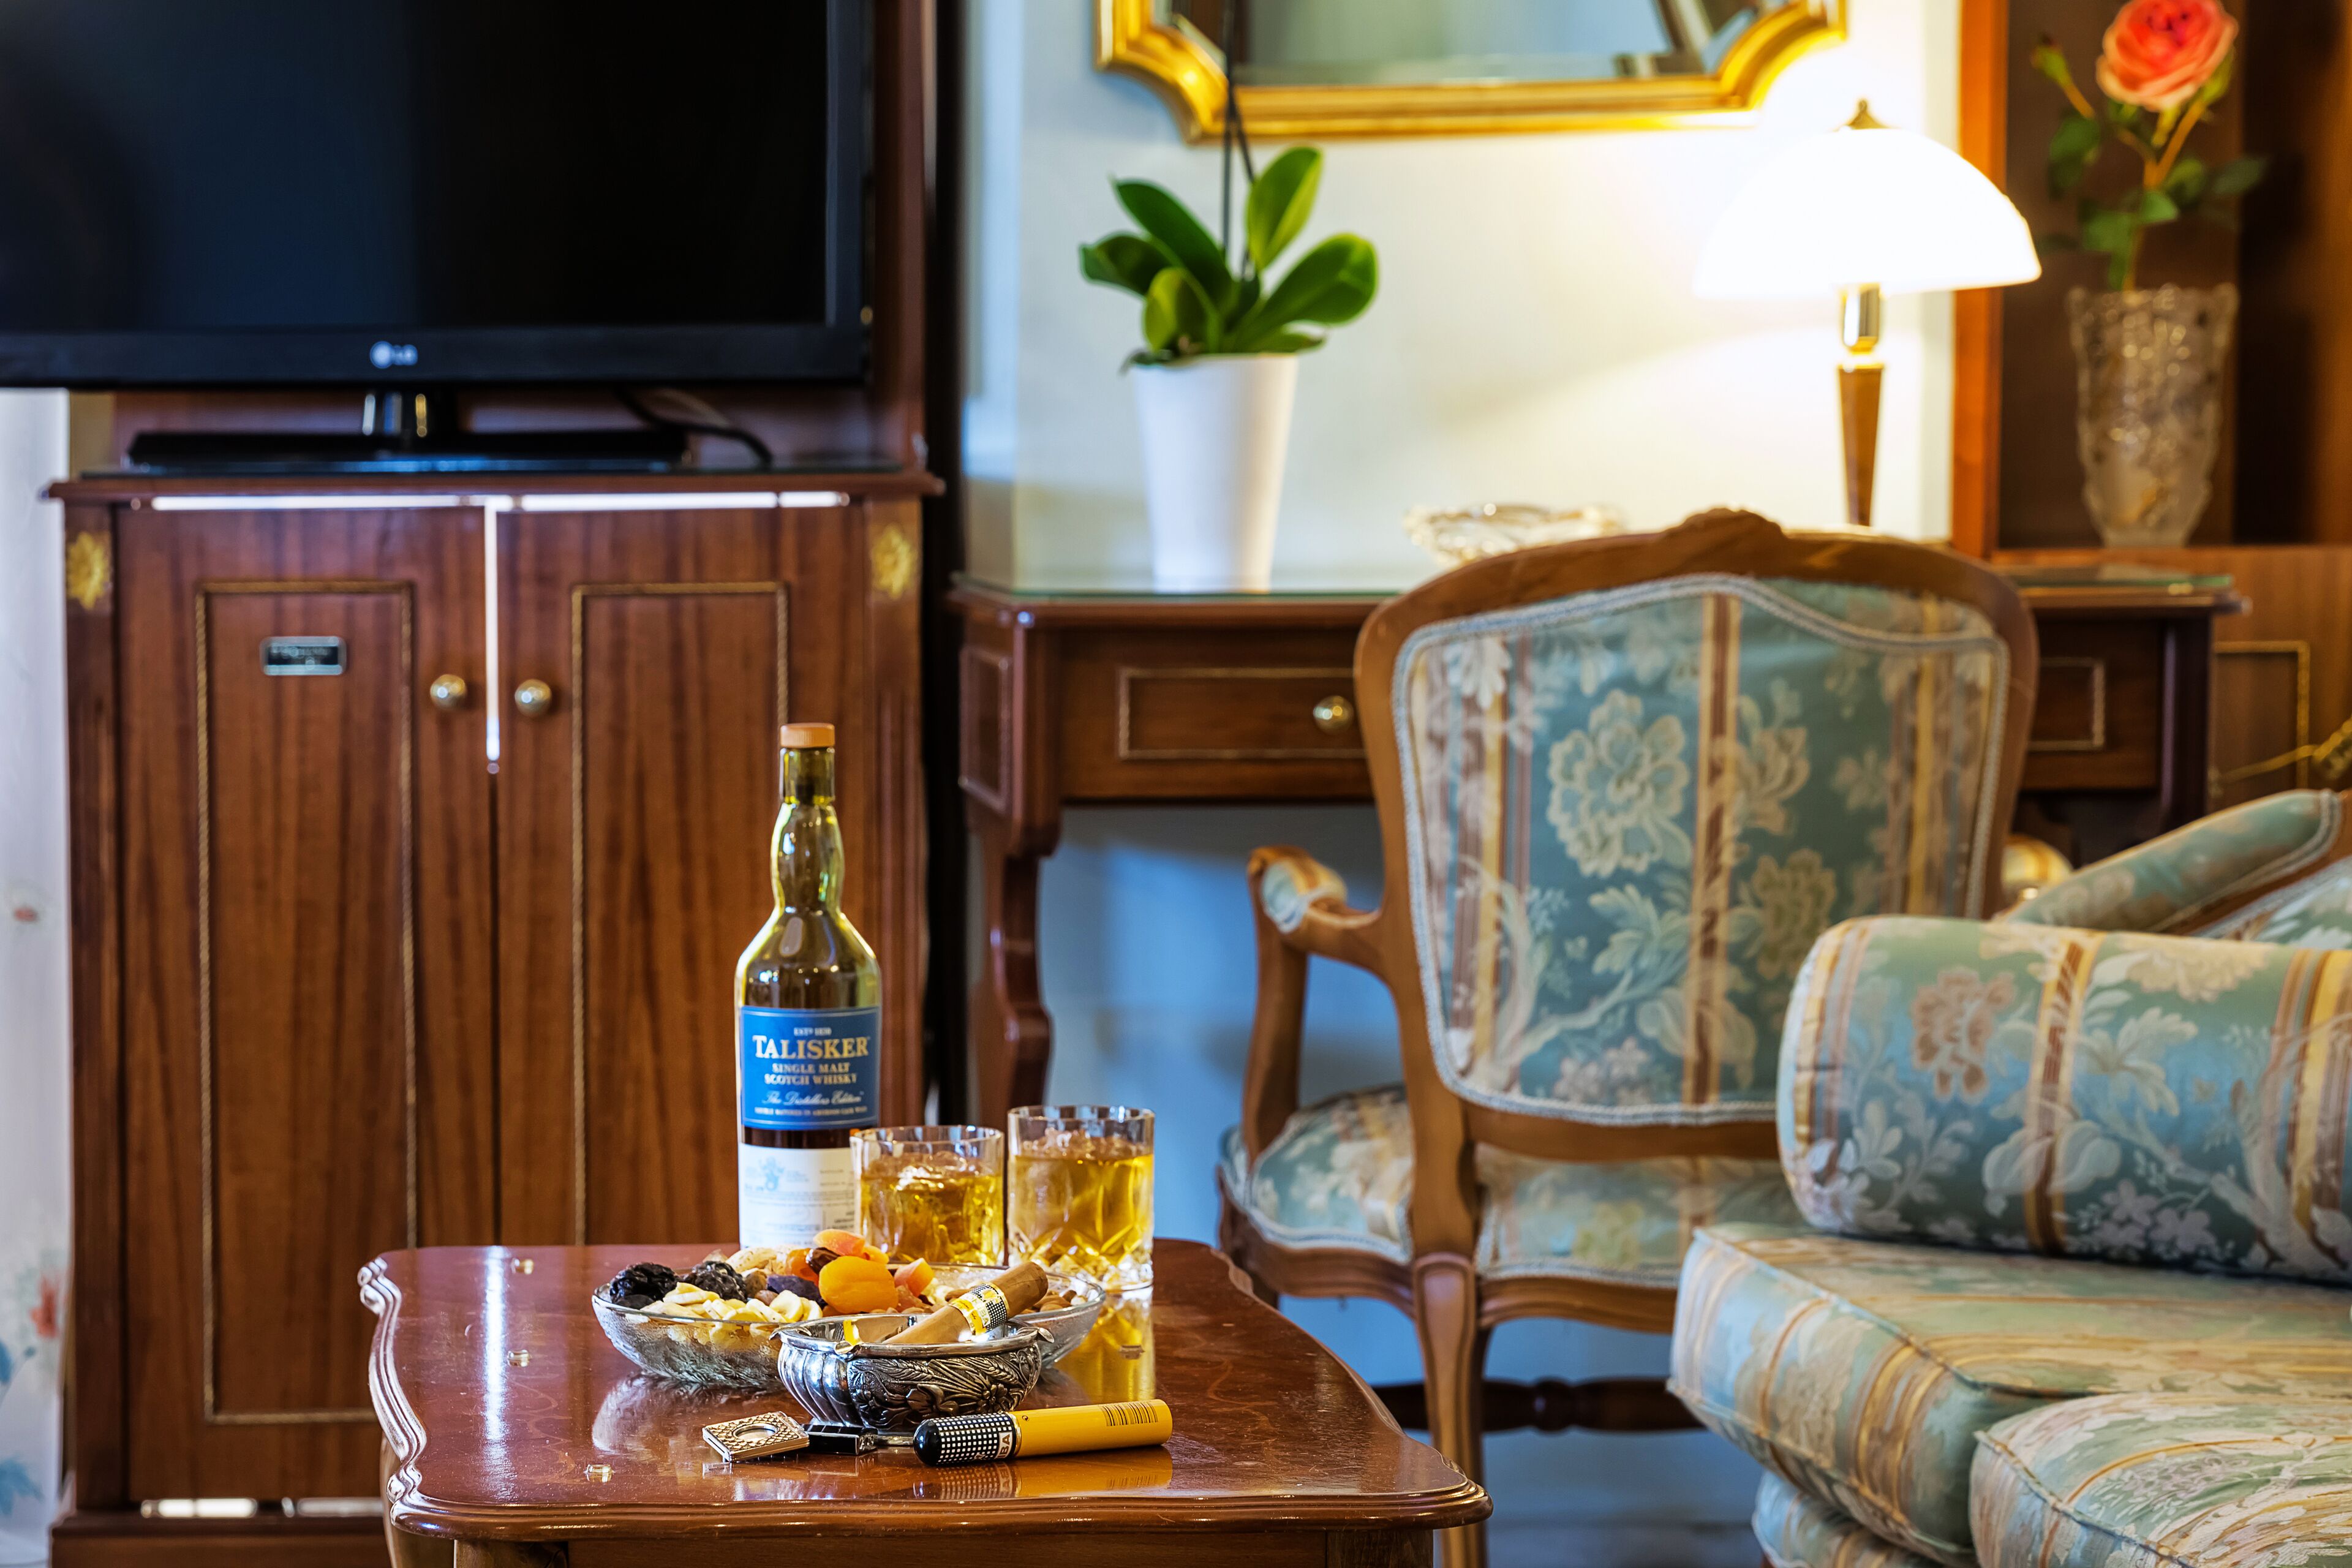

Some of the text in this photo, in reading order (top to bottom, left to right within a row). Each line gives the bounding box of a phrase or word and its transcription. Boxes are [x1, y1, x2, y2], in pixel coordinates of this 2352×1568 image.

[752, 1035, 869, 1059] TALISKER
[772, 1062, 850, 1074] SINGLE MALT
[764, 1073, 856, 1085] SCOTCH WHISKY
